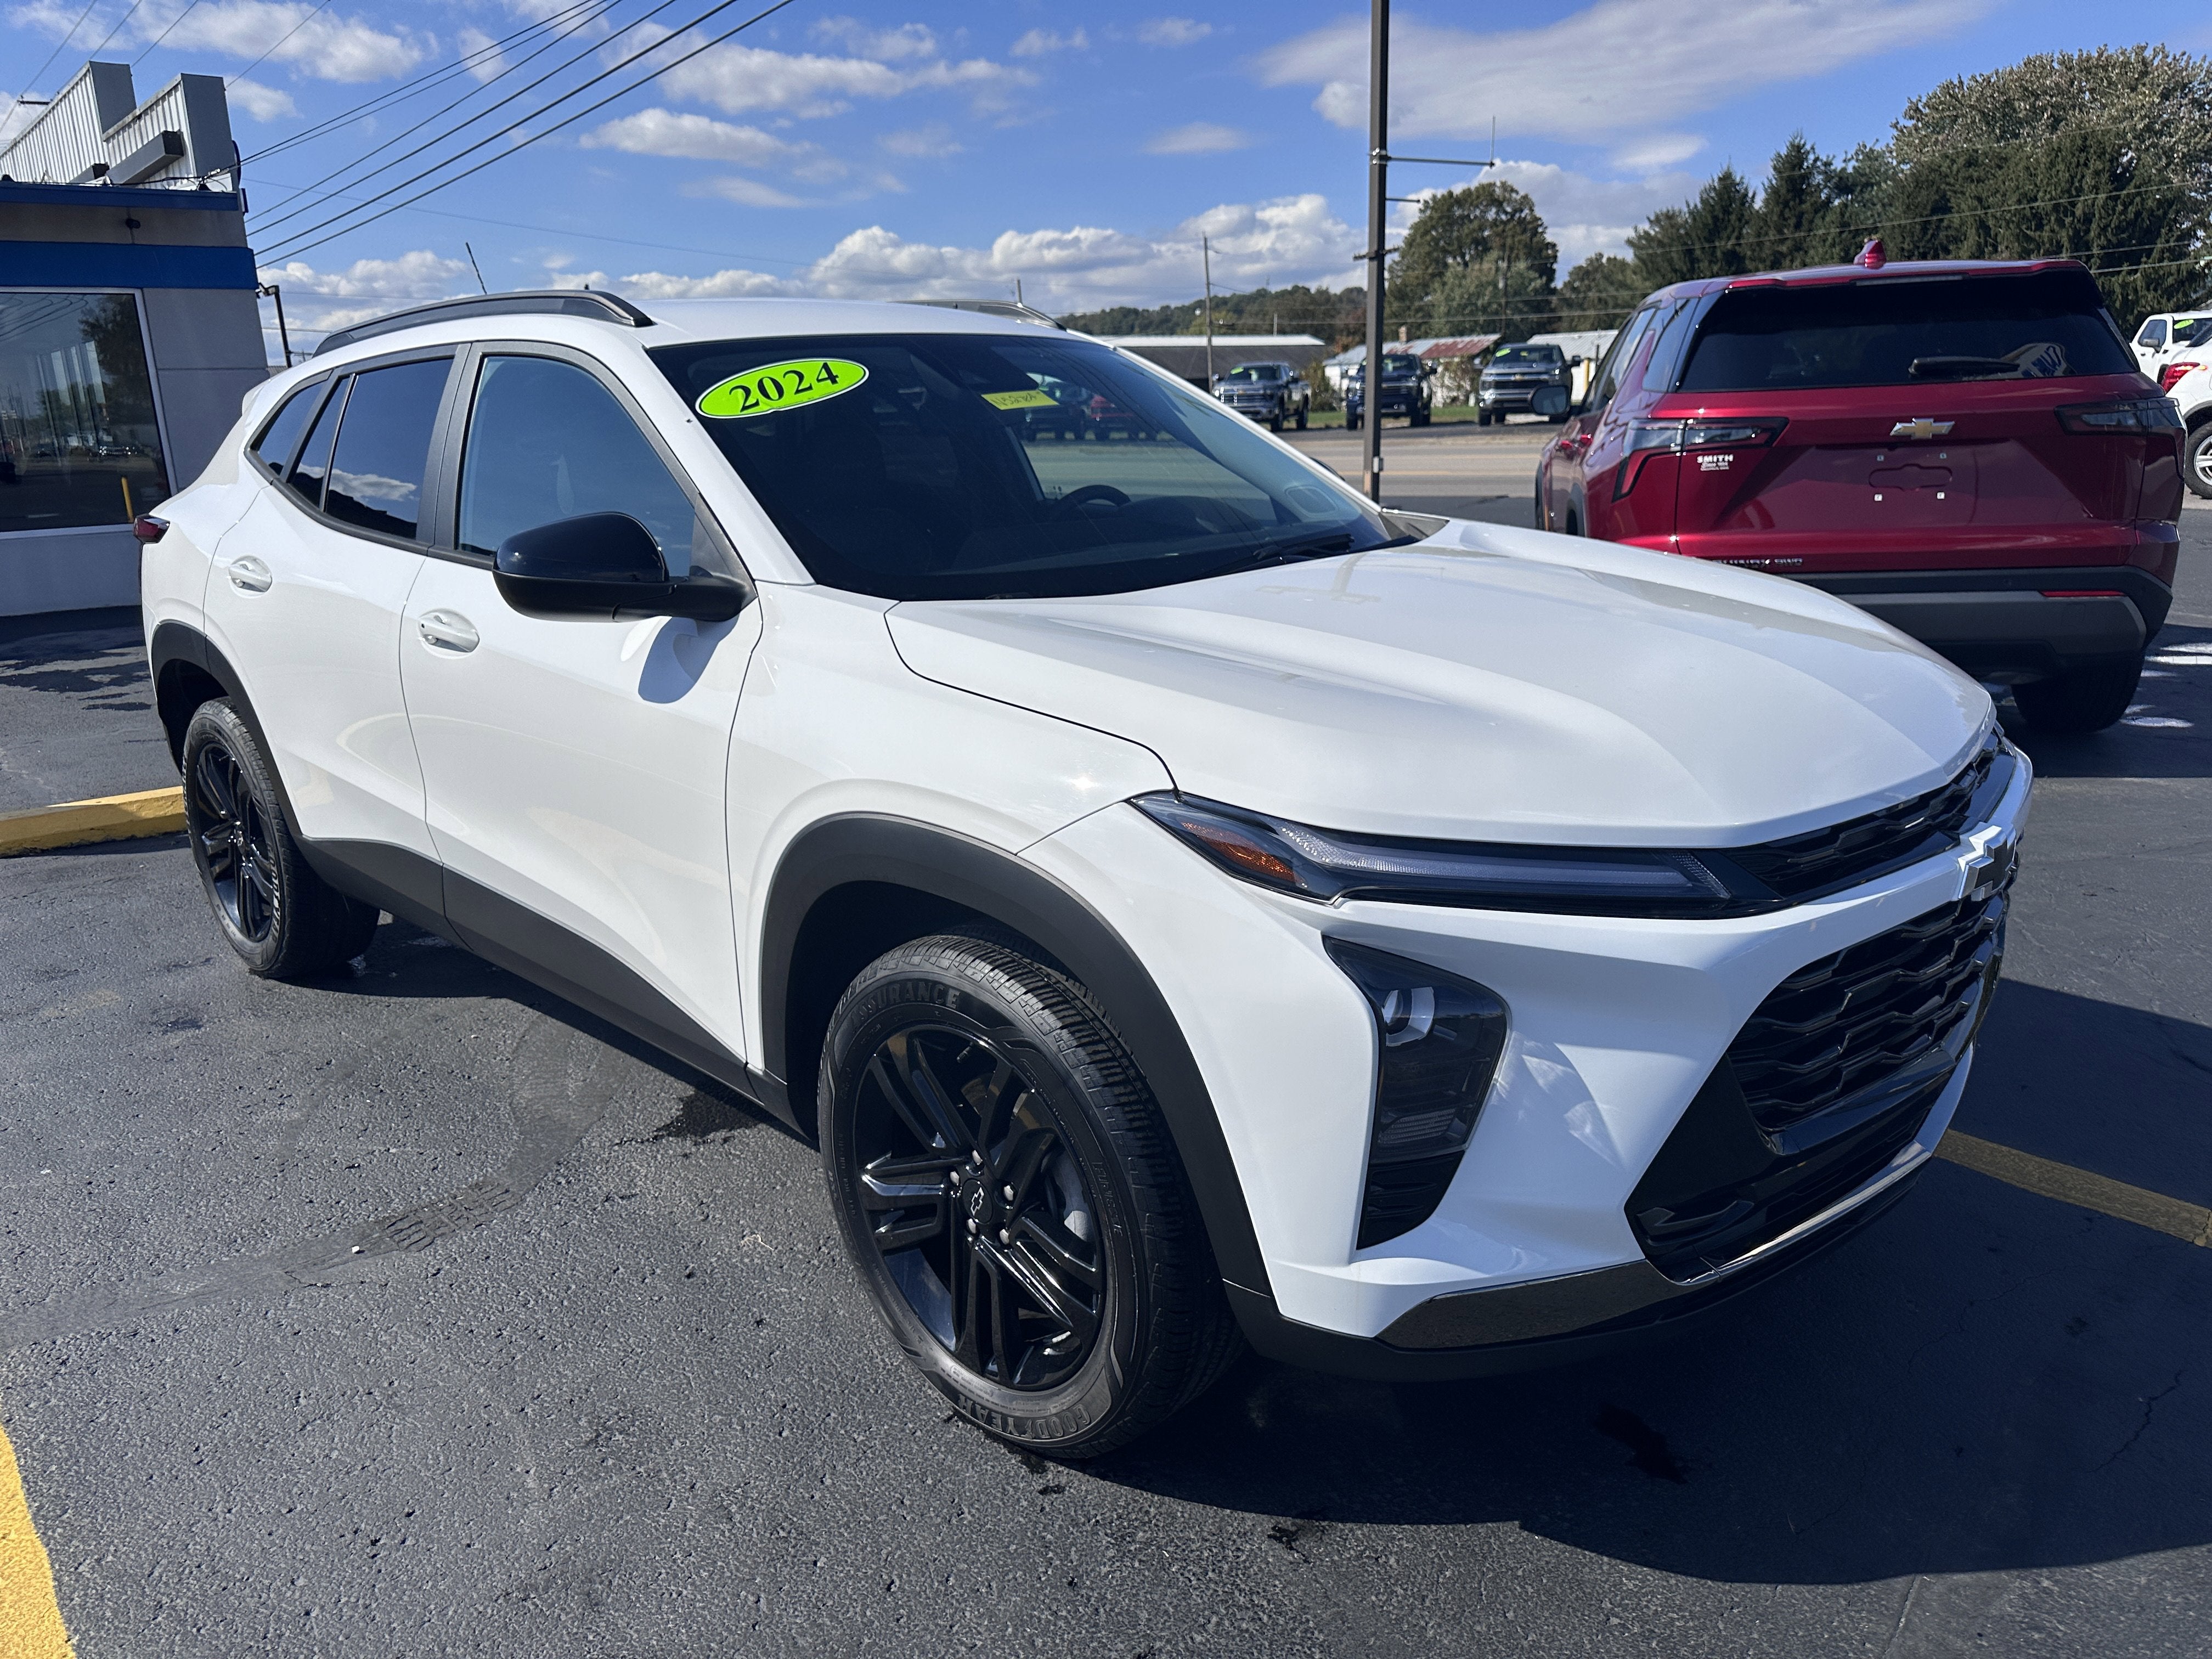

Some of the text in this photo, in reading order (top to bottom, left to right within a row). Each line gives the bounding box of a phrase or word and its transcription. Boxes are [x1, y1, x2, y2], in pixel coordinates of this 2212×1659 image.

[729, 362, 839, 413] 2024
[1696, 454, 1734, 463] SMITH
[850, 981, 961, 1030] ASSURANCE
[958, 1393, 1091, 1440] GOODYEAR
